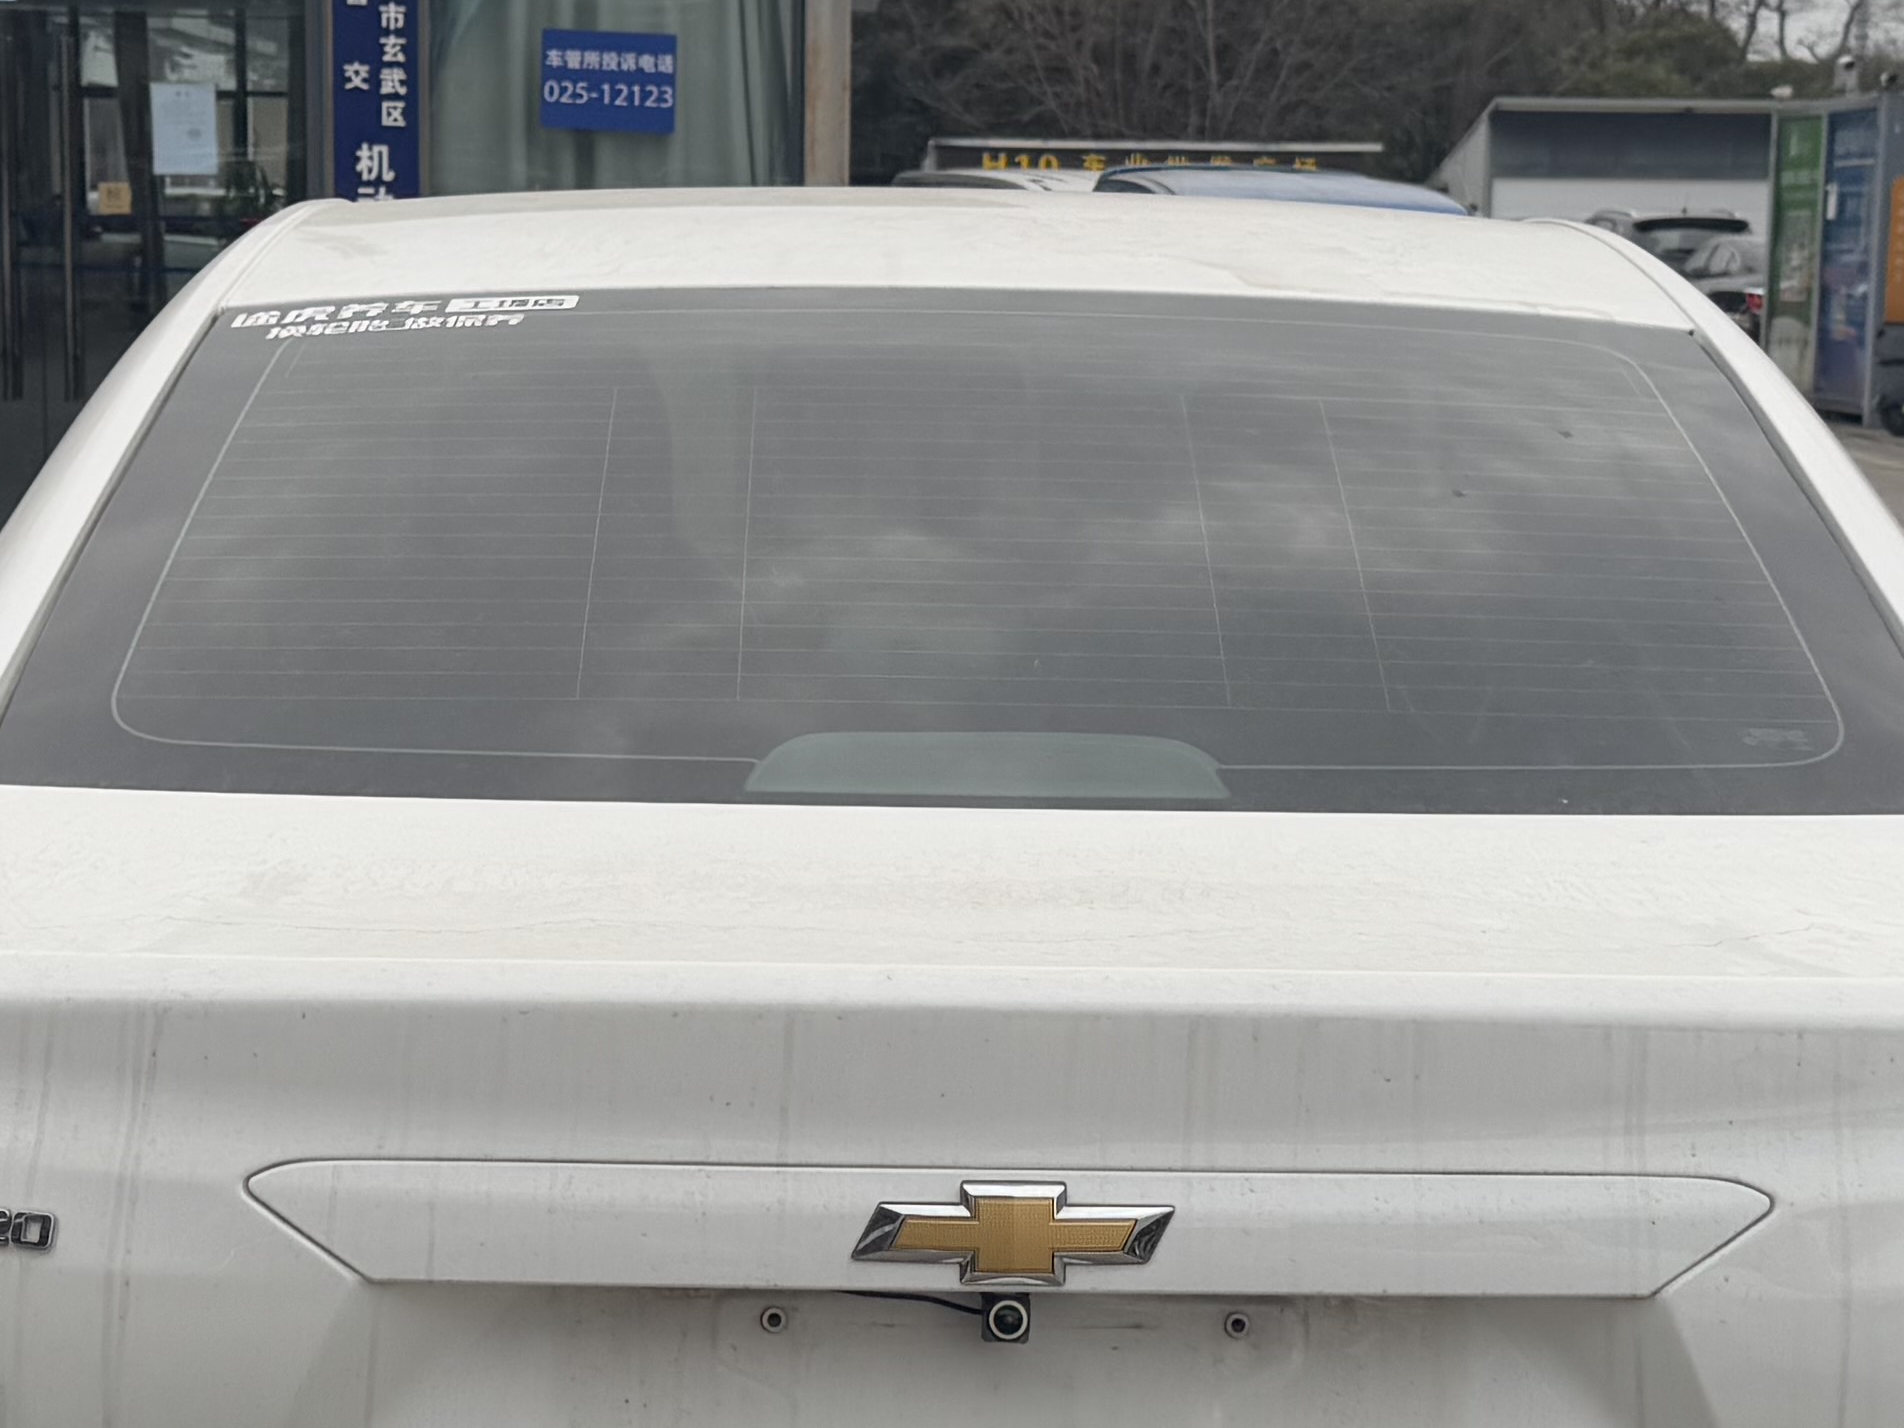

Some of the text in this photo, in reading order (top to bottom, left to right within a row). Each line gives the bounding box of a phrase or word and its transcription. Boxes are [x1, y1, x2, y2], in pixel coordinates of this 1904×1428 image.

[545, 48, 674, 74] 车管所投诉电话
[543, 79, 674, 108] 025-12123
